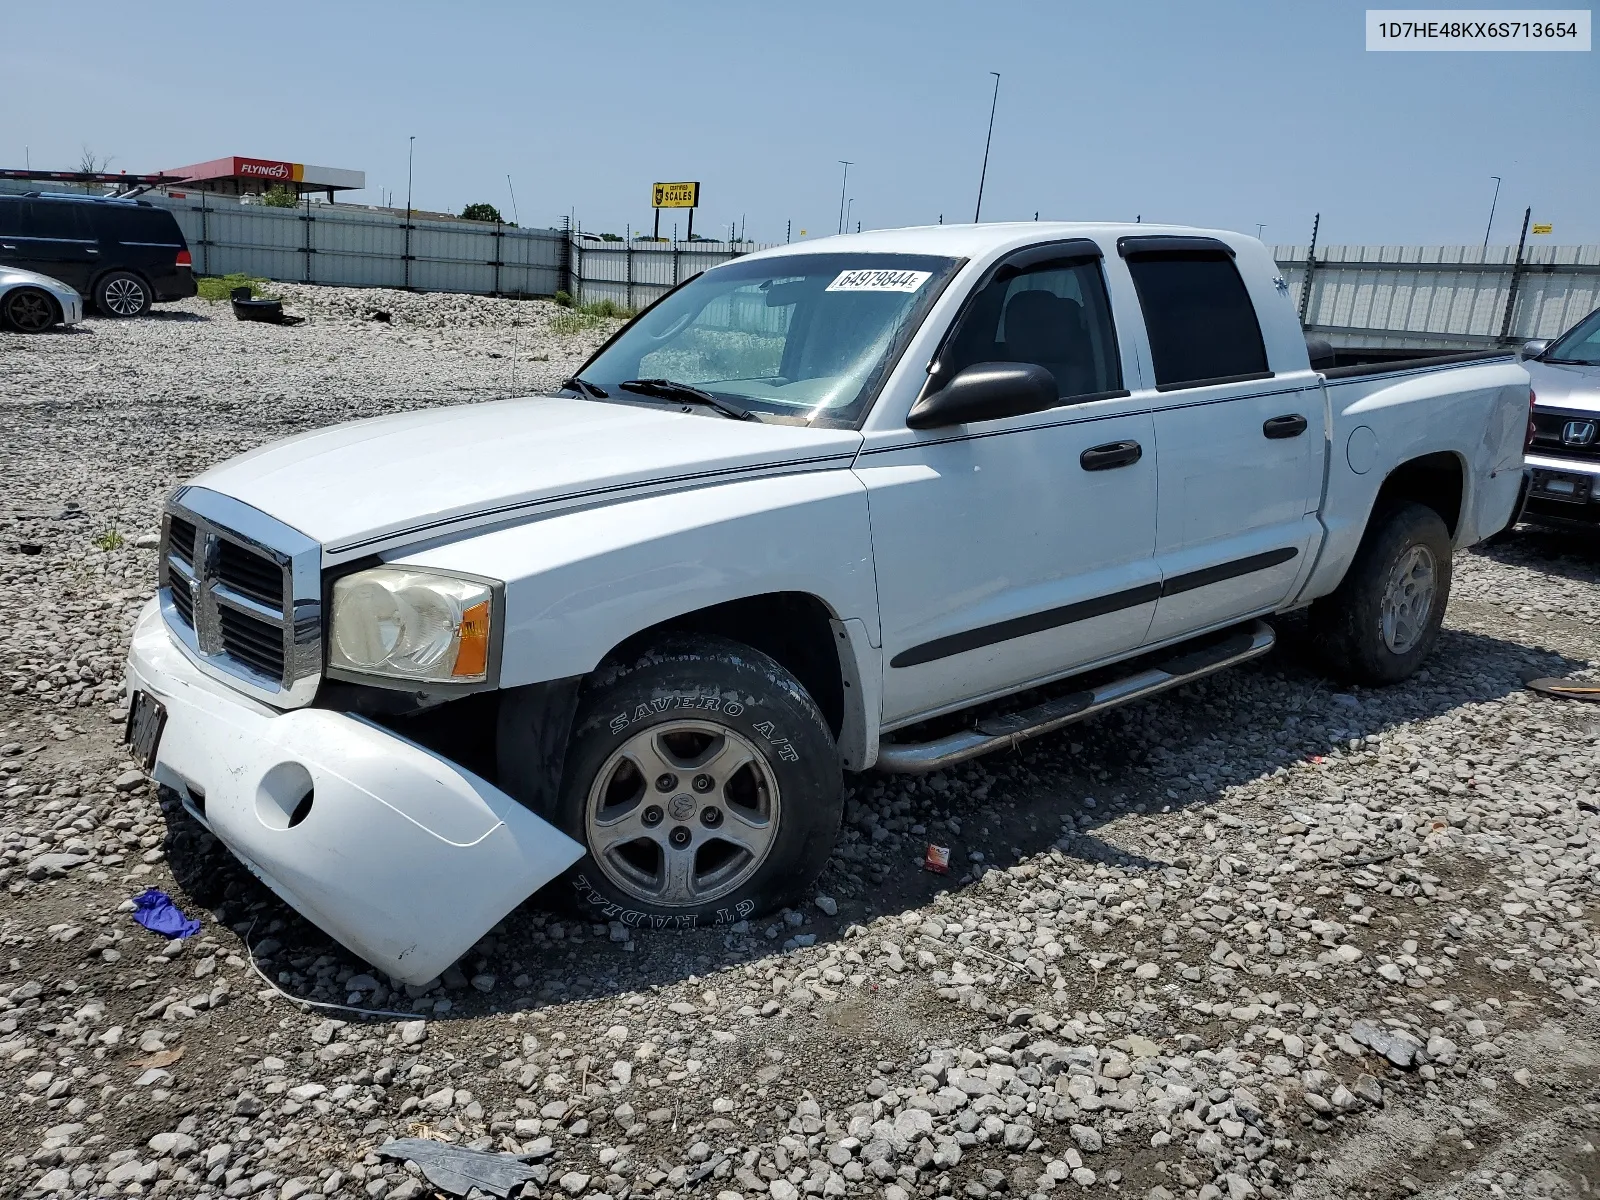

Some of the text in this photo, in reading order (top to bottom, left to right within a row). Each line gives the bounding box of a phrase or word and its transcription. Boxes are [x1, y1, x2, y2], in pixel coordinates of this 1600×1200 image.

[241, 163, 276, 176] FLYING
[665, 191, 692, 201] SCALES
[609, 695, 800, 765] SAVERO A/T
[715, 899, 755, 925] GT
